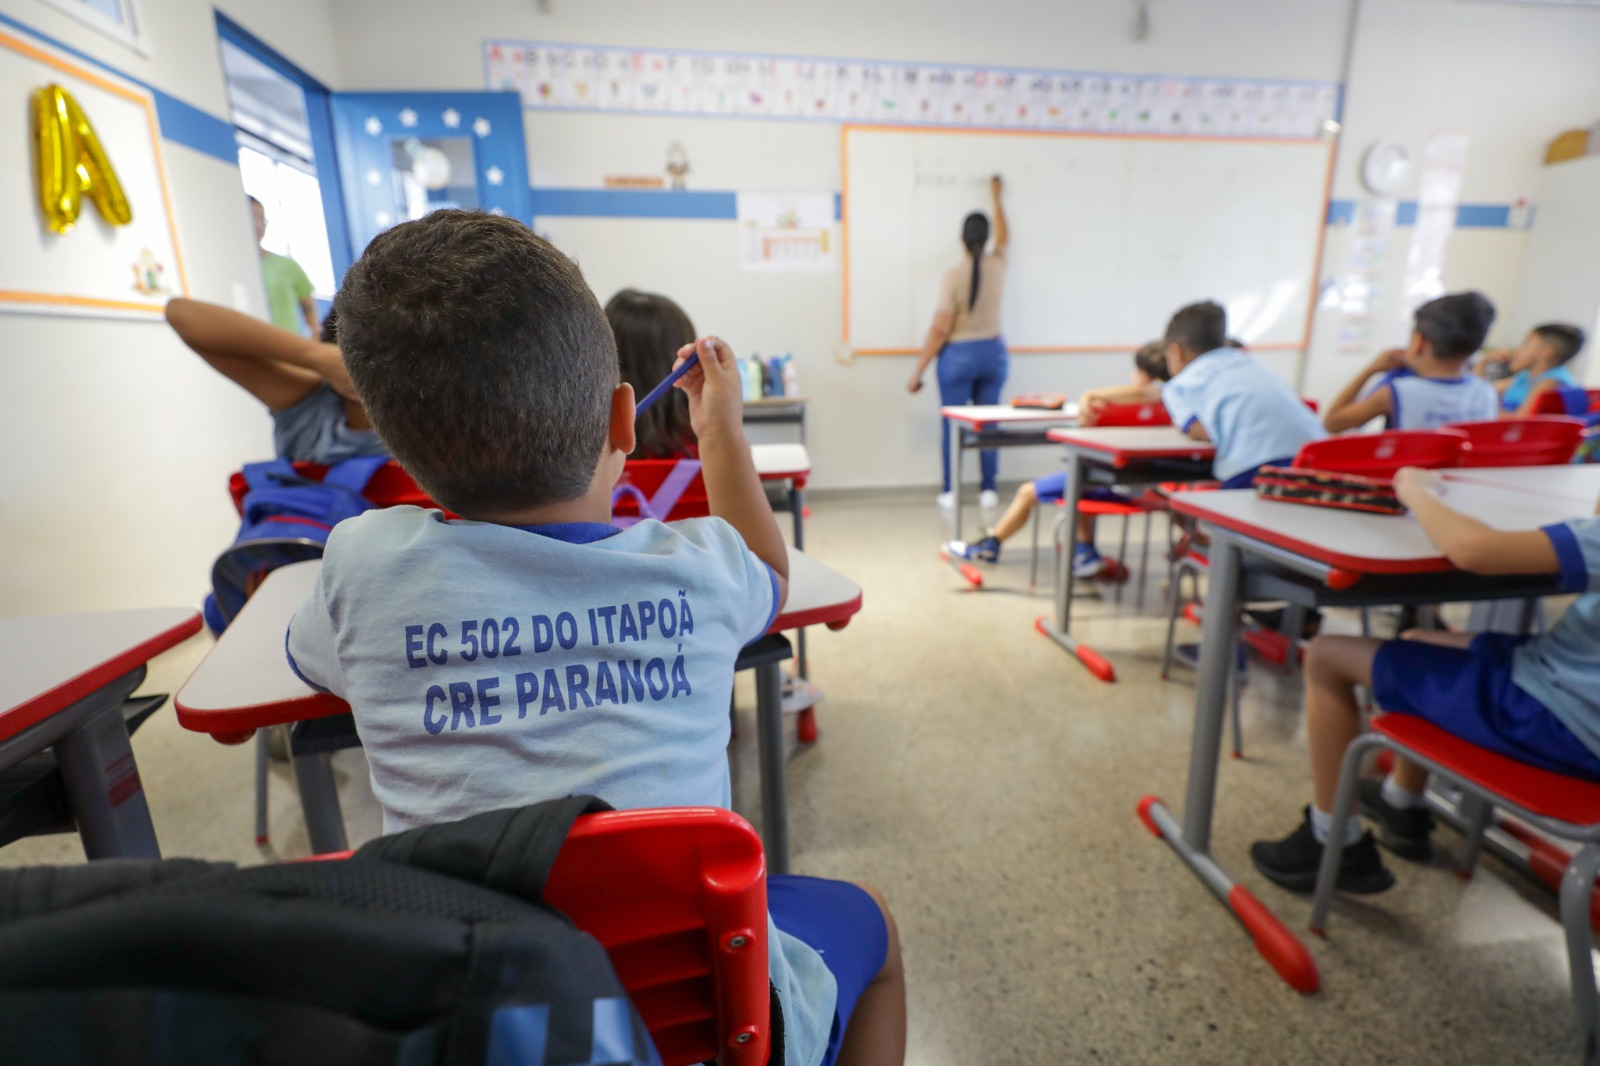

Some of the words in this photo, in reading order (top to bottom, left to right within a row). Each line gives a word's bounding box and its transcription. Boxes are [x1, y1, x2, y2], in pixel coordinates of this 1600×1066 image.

[32, 83, 132, 234] A
[405, 622, 448, 669] EC
[460, 617, 521, 662] 502
[532, 611, 578, 654] DO
[588, 589, 694, 646] ITAPOÃ
[423, 677, 502, 735] CRE
[515, 643, 692, 719] PARANOÁ
